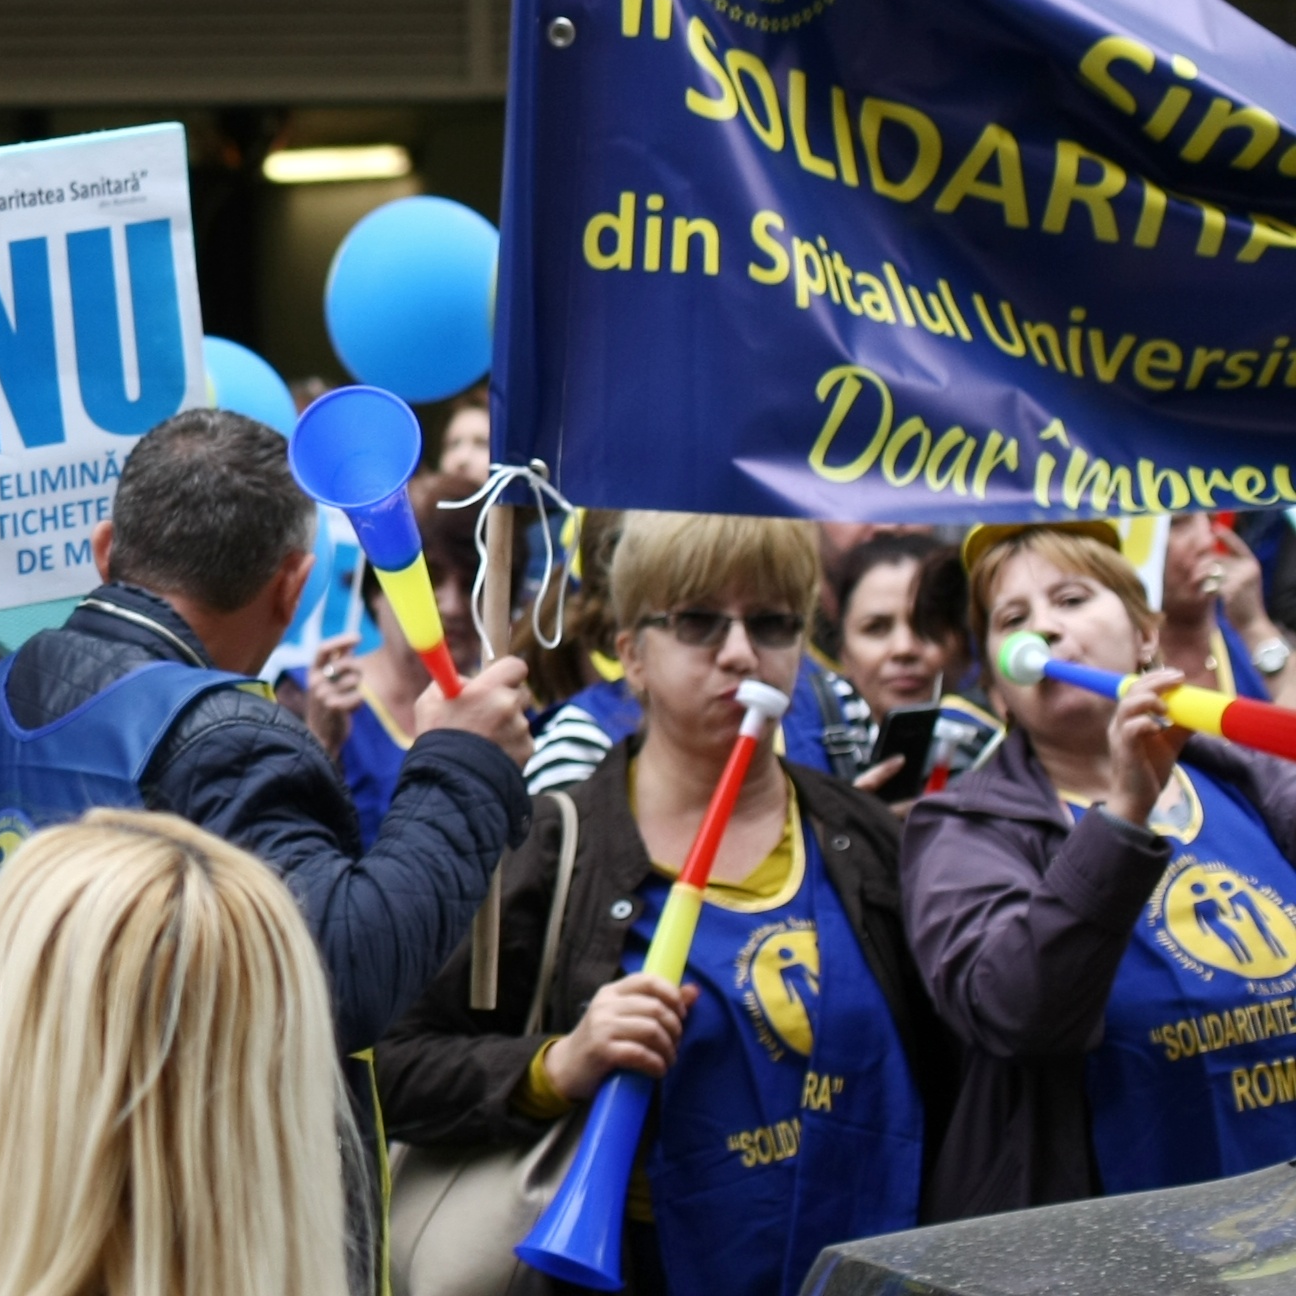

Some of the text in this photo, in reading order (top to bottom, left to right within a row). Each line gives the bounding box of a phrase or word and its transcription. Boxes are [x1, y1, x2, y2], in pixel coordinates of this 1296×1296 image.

[1079, 34, 1296, 176] Sin
[583, 191, 721, 277] din
[748, 209, 975, 344] Spitalul
[809, 364, 1020, 502] Doar
[17, 543, 55, 576] DE
[1230, 1055, 1296, 1113] ROM
